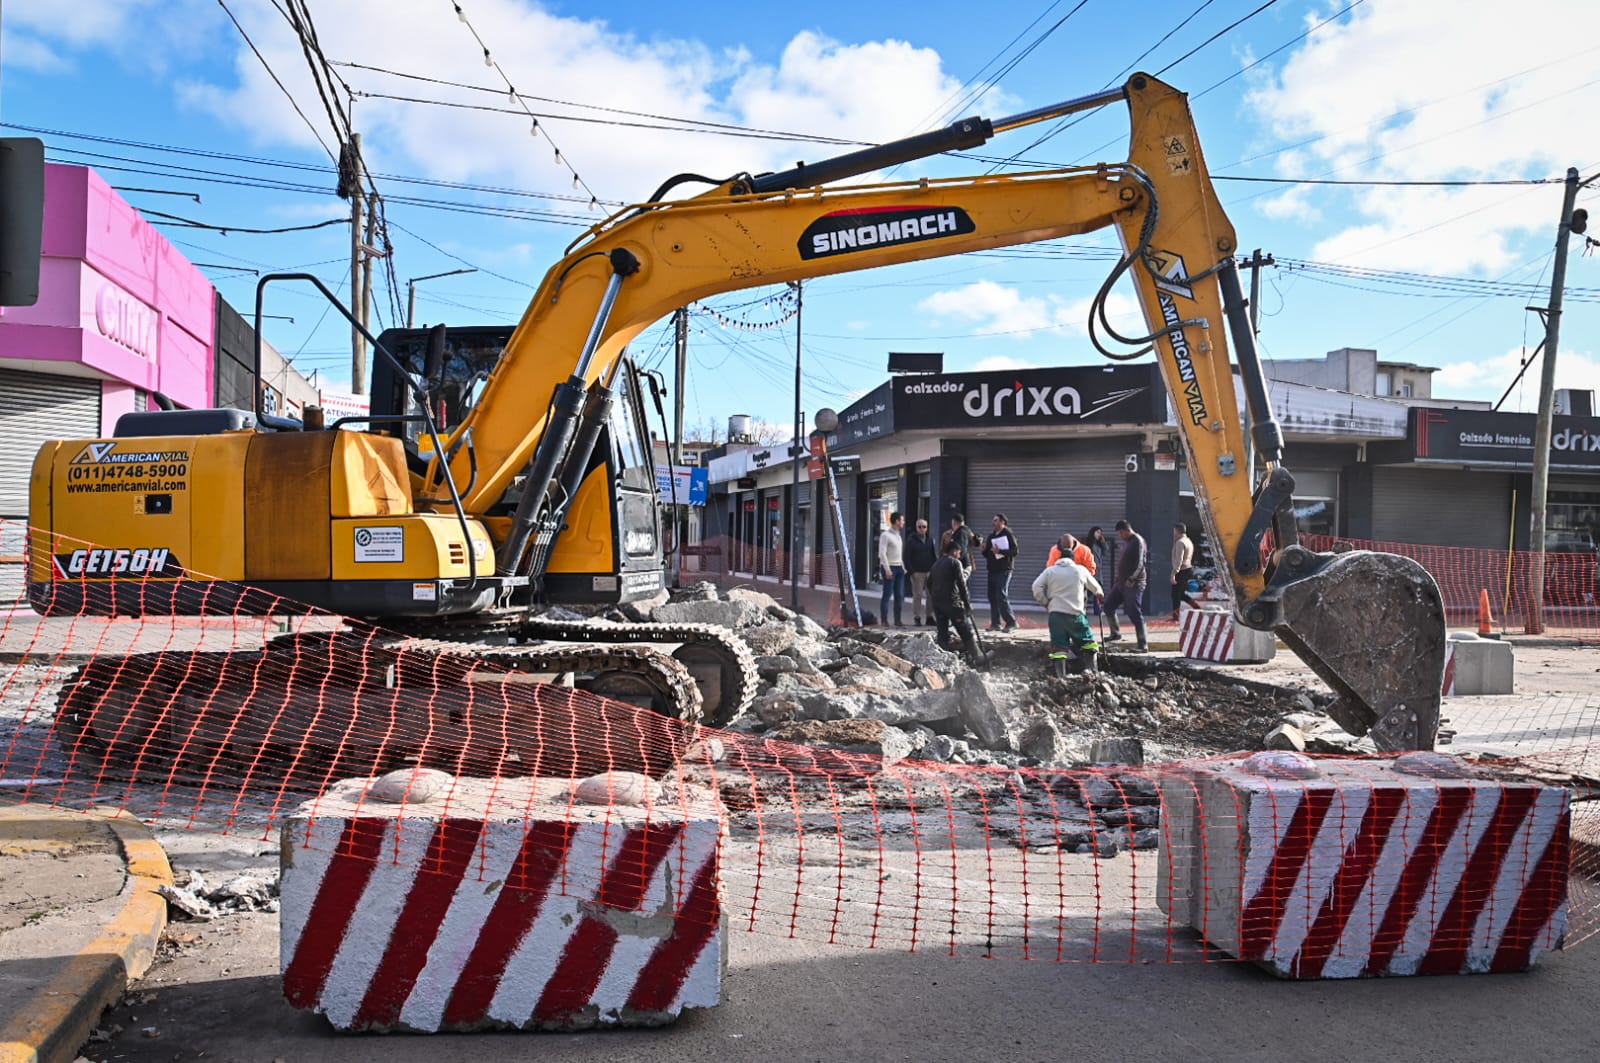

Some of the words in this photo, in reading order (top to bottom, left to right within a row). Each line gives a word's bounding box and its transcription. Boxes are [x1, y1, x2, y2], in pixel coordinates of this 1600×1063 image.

[812, 211, 957, 254] SINOMACH
[1158, 291, 1195, 382] AMRICAN
[904, 380, 964, 394] calzados
[963, 380, 1081, 417] drixa
[1459, 432, 1493, 443] Calzado
[68, 464, 187, 482] (011)4748-5900
[67, 479, 186, 493] www.americanvial.com
[68, 548, 169, 573] GE150H
